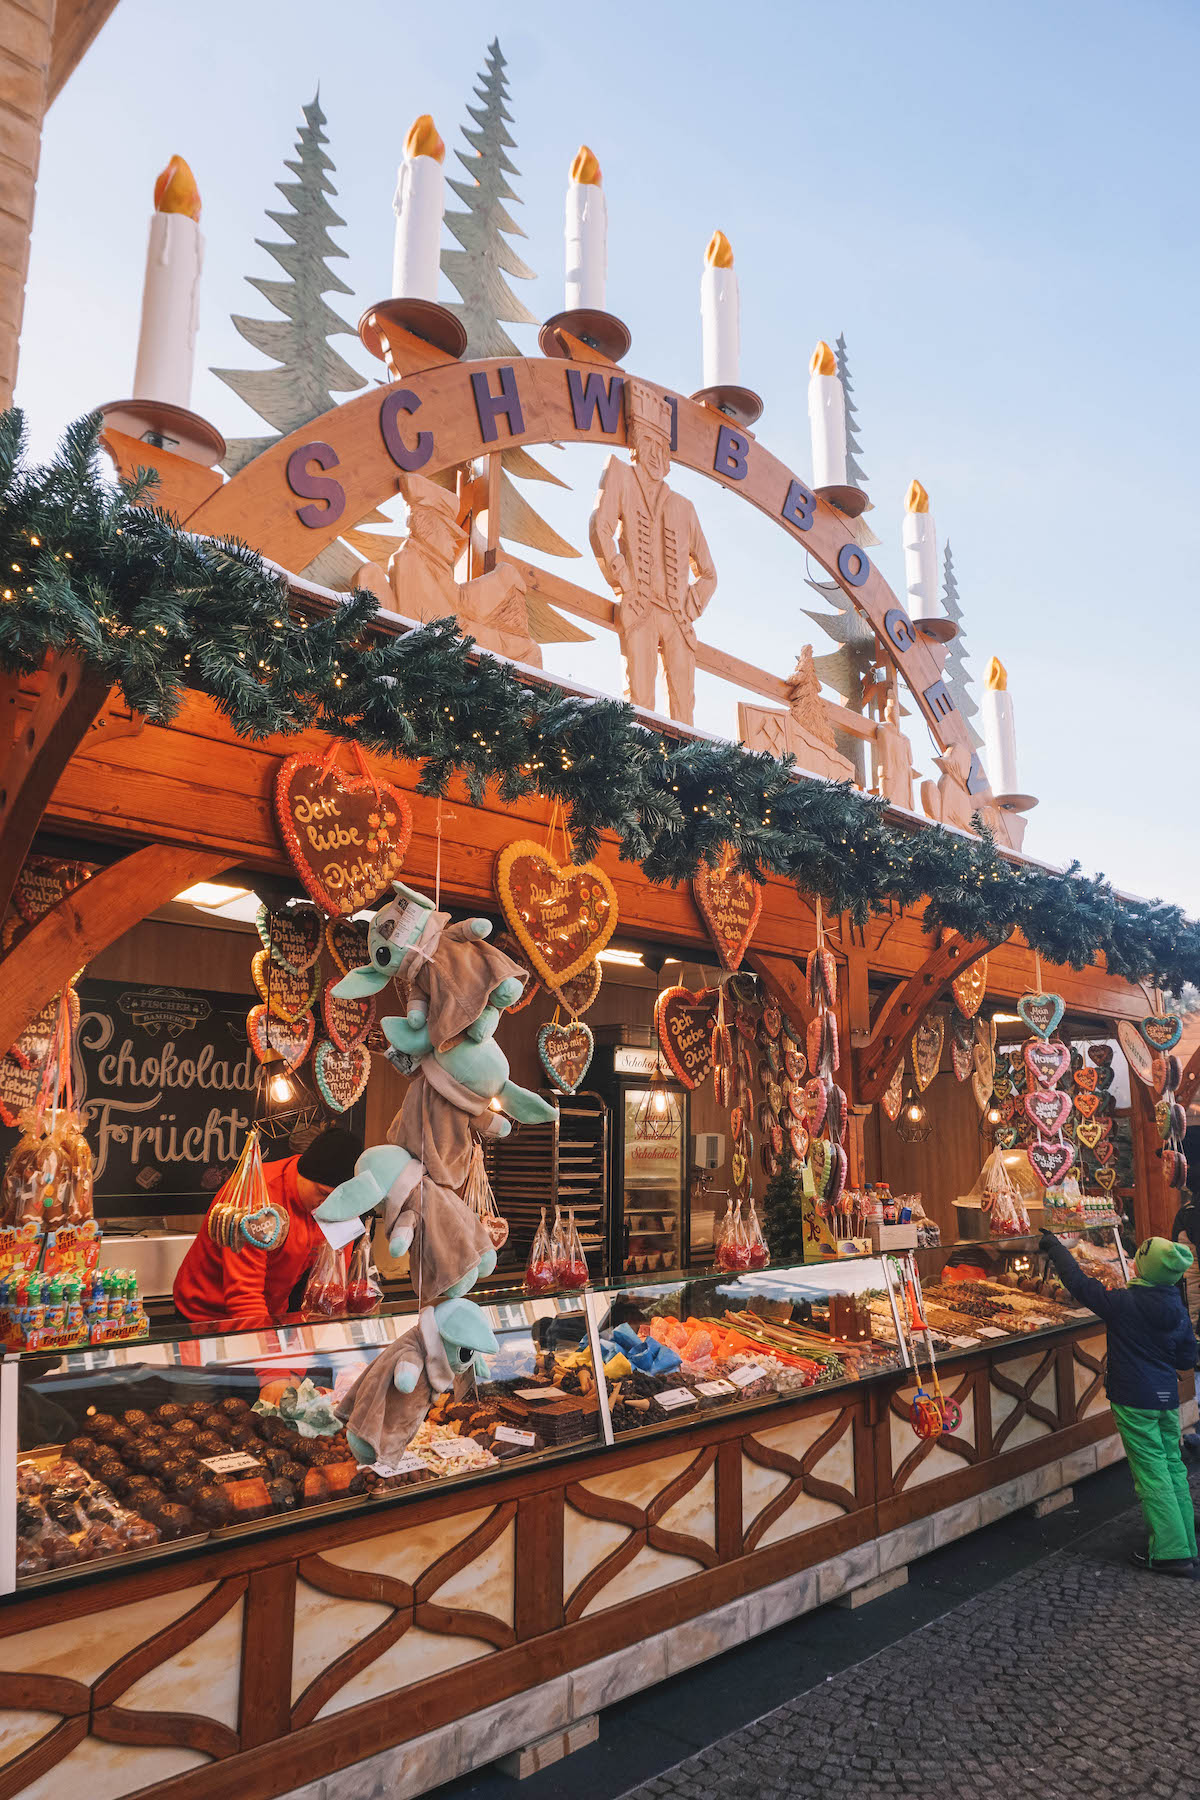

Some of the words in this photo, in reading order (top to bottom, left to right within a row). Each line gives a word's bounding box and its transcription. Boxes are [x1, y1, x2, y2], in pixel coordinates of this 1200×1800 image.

[293, 795, 342, 823] Ich
[306, 823, 364, 852] liebe
[323, 856, 376, 889] Dich
[140, 999, 191, 1012] FISCHER
[143, 1013, 187, 1025] BAMBERG
[669, 1012, 694, 1036] Ich
[677, 1028, 706, 1051] liebe
[684, 1044, 713, 1068] Dich
[1033, 1054, 1060, 1067] Honey
[78, 1092, 270, 1183] Frücht
[250, 1221, 273, 1235] Papa
